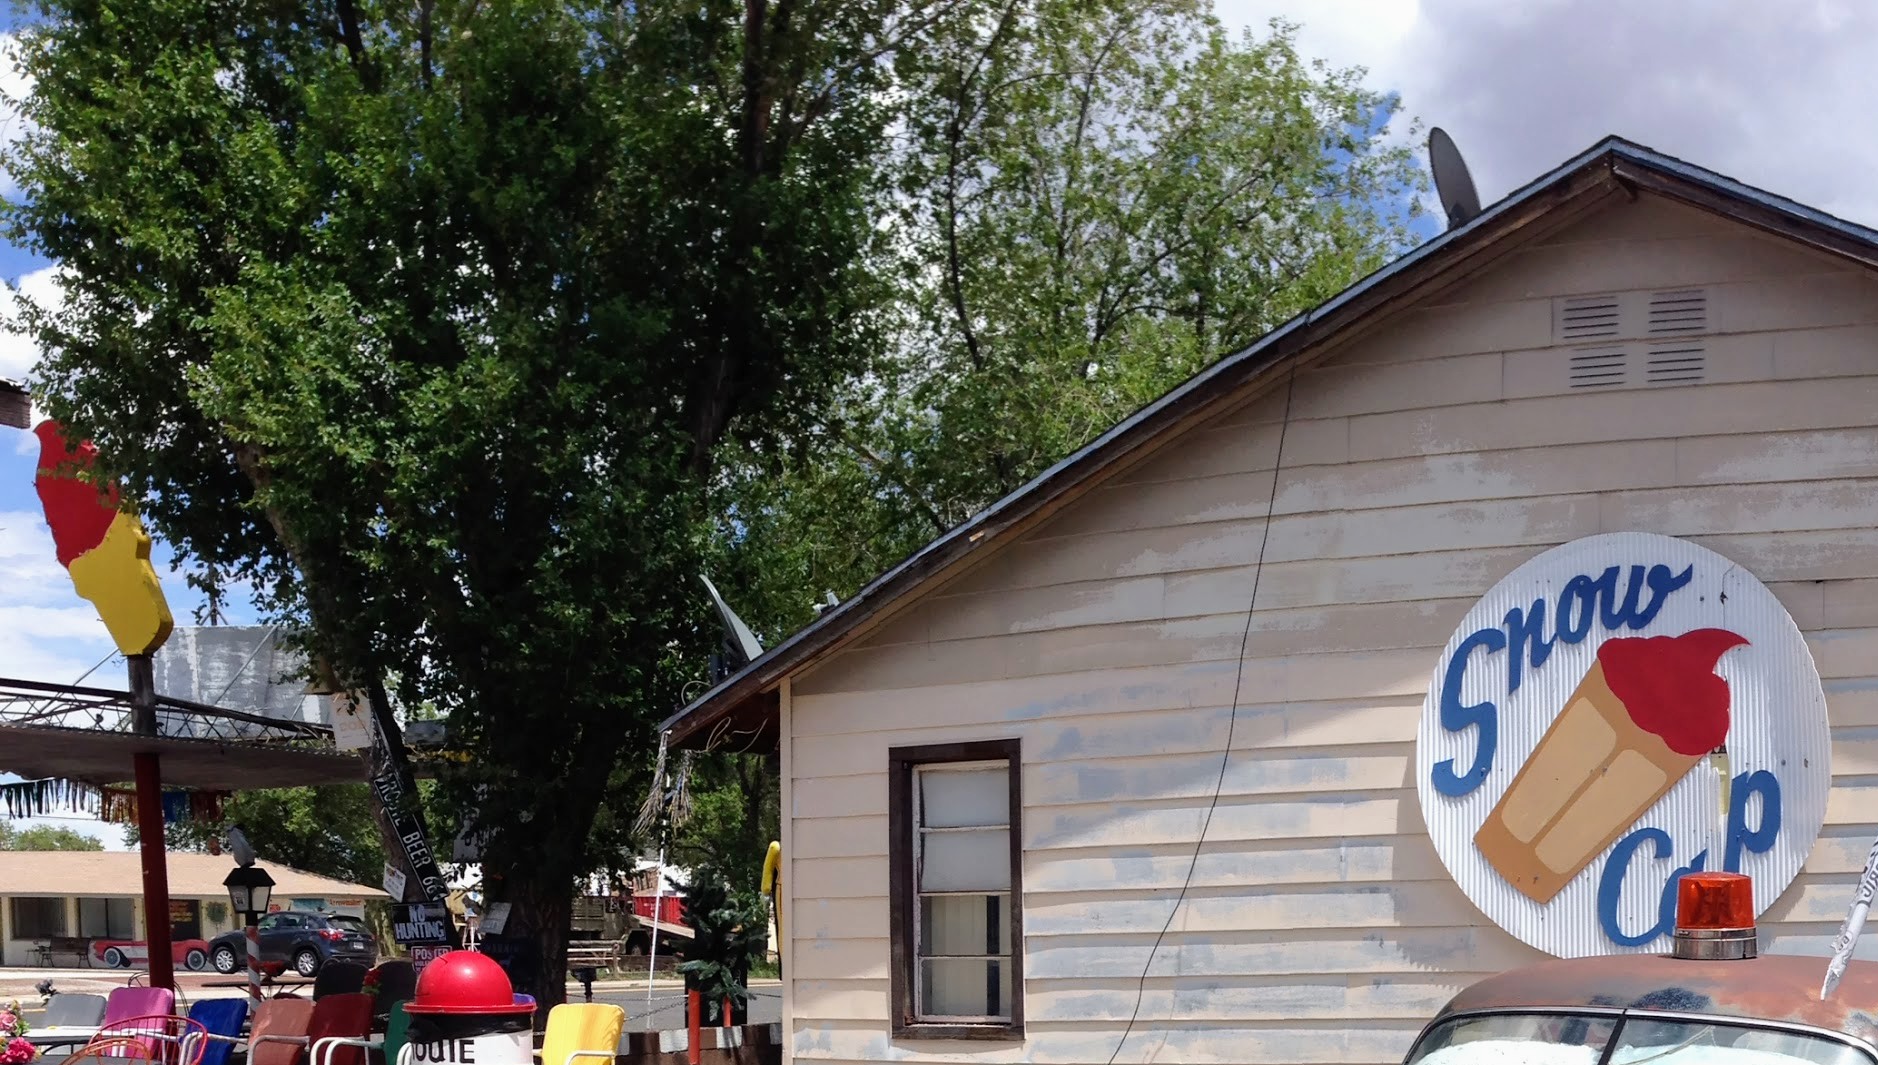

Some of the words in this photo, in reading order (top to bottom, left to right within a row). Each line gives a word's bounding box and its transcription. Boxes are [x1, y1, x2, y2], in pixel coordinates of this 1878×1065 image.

[1432, 563, 1693, 797] Snow
[402, 832, 431, 868] BEER
[408, 904, 426, 924] NO
[395, 920, 446, 942] HUNTING
[411, 1039, 476, 1065] OUTE
